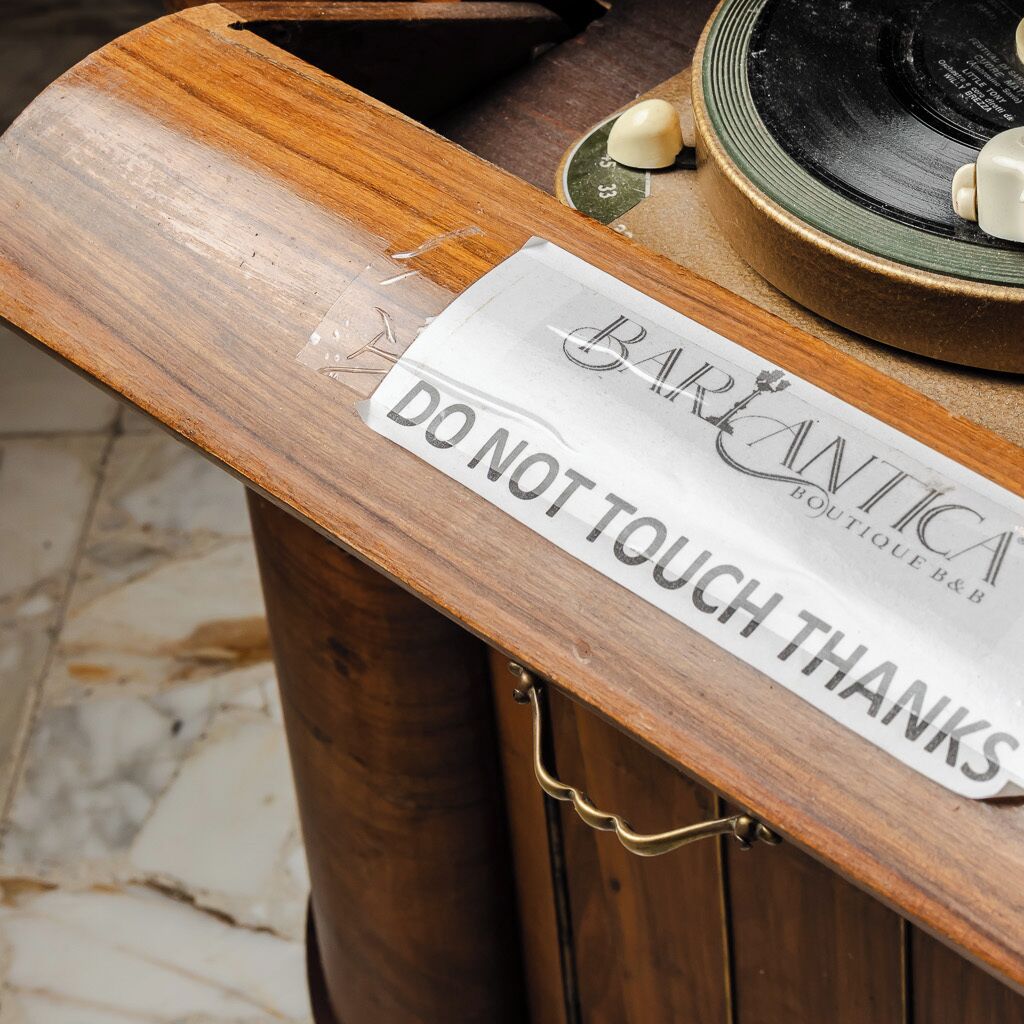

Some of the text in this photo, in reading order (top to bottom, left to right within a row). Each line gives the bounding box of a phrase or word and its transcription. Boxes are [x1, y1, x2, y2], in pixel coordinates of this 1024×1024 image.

[938, 58, 967, 83] Orchestra
[974, 54, 1005, 78] CUORE
[943, 72, 993, 113] WILLY BREZZA
[961, 68, 1007, 104] LITTLE TONY
[597, 183, 618, 199] 33
[789, 486, 927, 570] BOUTIQUE
[386, 378, 1021, 783] DO NOT TOUCH THANKS
